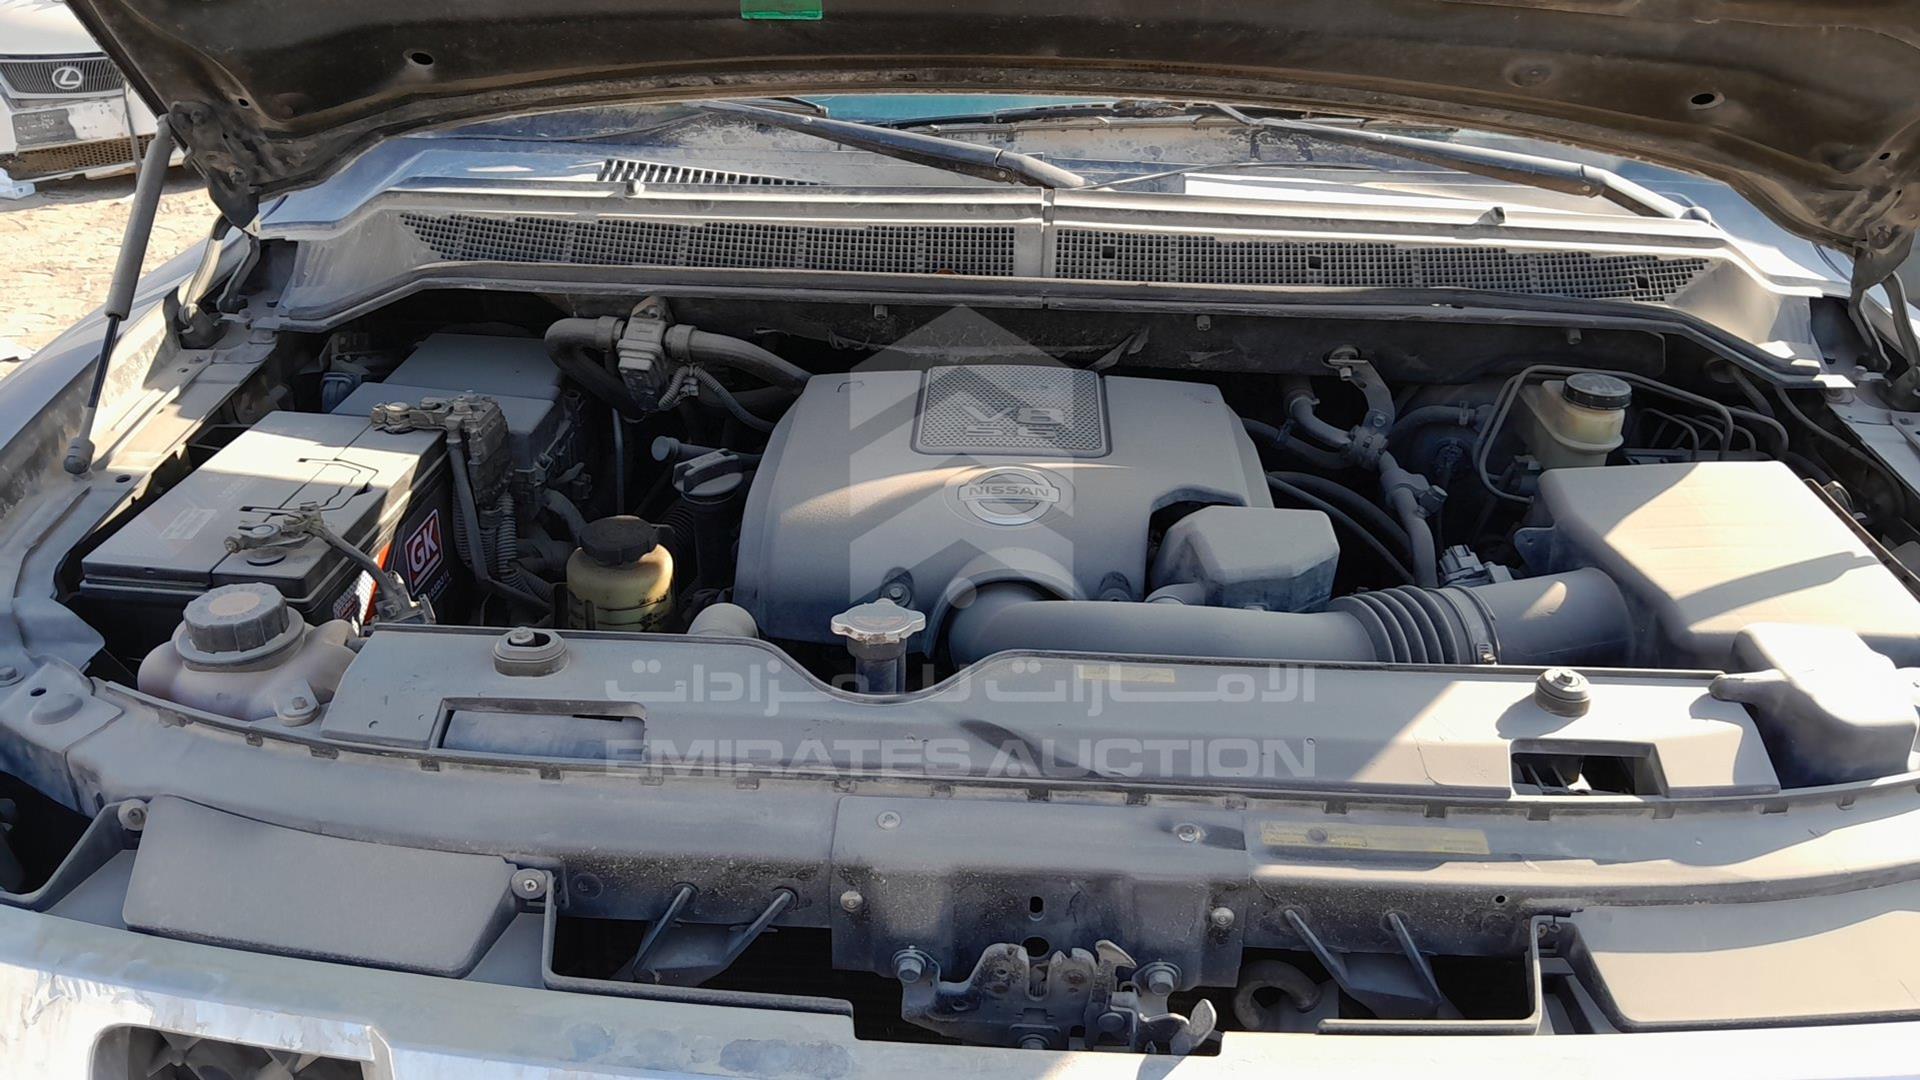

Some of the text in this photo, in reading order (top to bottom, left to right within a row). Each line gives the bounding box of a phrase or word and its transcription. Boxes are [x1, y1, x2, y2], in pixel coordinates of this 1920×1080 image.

[959, 404, 1064, 425] V8
[969, 485, 1049, 497] NISSAN
[410, 518, 438, 573] GK
